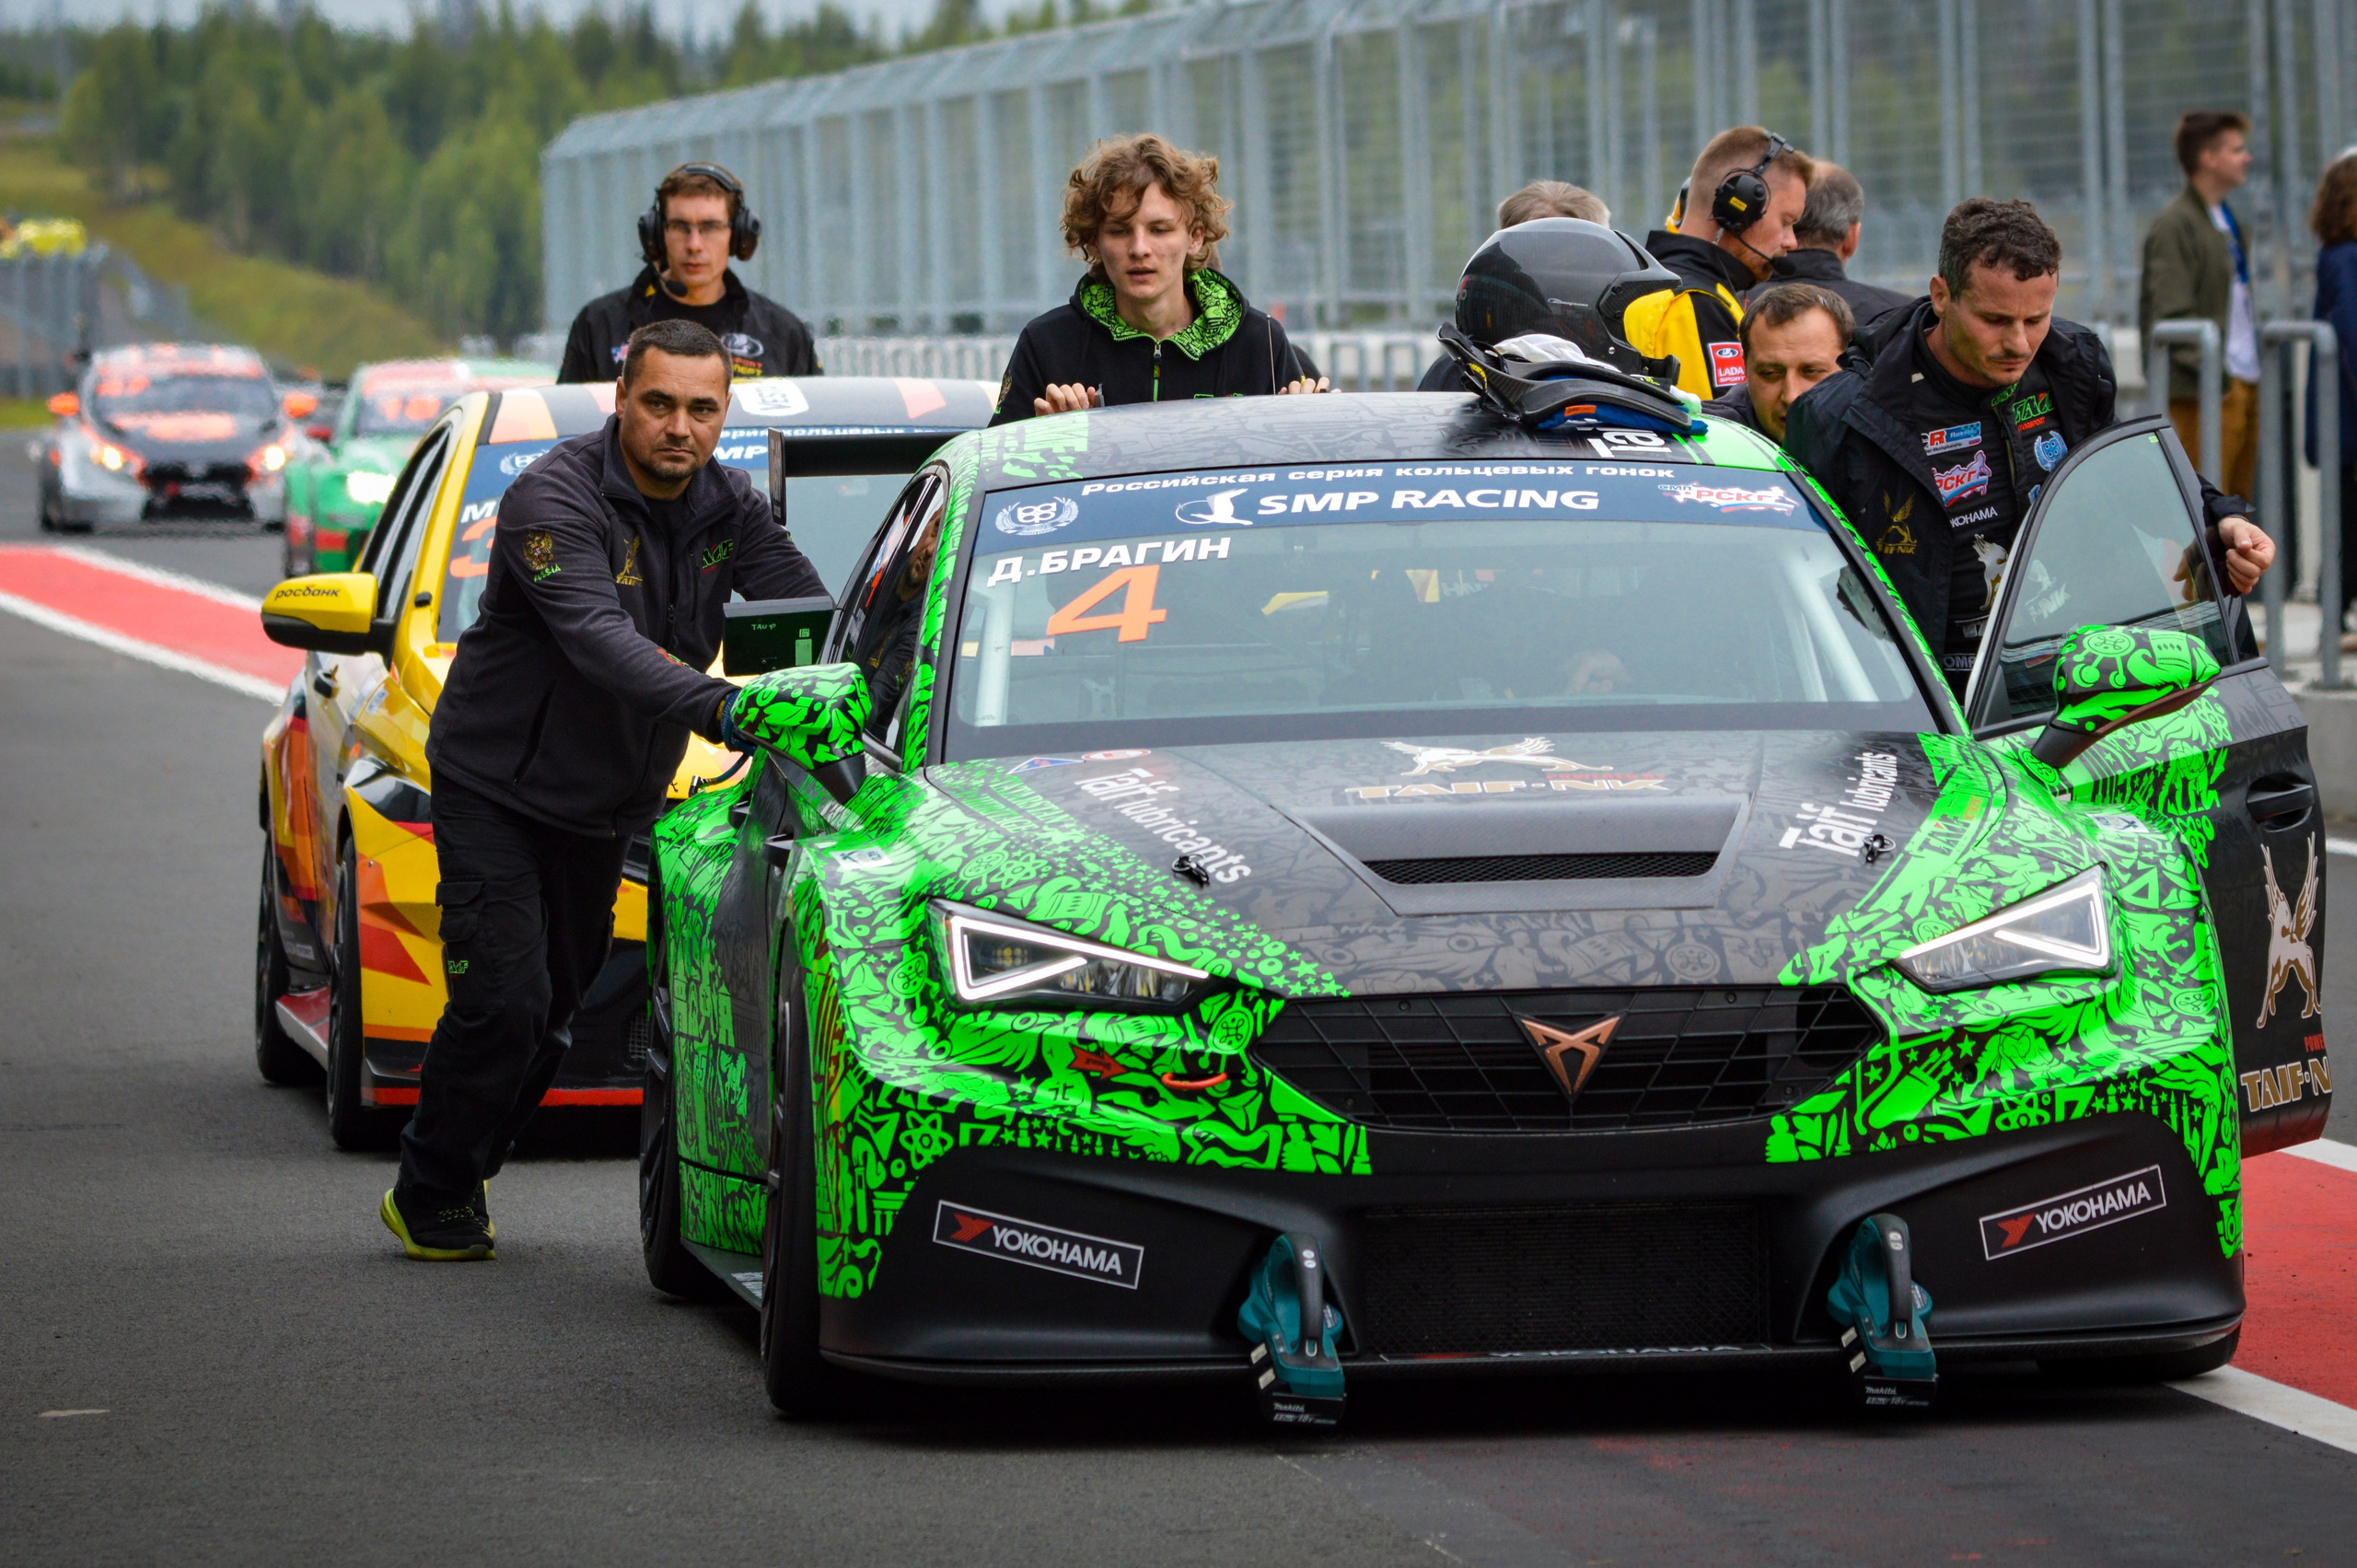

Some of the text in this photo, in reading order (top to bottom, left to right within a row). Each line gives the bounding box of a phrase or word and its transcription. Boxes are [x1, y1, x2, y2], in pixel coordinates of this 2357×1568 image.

[1718, 366, 1745, 377] LADA
[714, 445, 768, 460] MP
[1081, 465, 1676, 497] Российская серия кольцевых гонок
[1257, 488, 1600, 516] SMP RACING
[1695, 489, 1772, 503] РСКГ
[1949, 505, 1998, 528] KOHAMA
[533, 563, 562, 582] RUSSIA
[987, 536, 1233, 588] Д.БРАГИН
[274, 585, 341, 601] росбанк
[1046, 563, 1167, 645] 4
[1839, 750, 1898, 811] lubricants
[1113, 798, 1252, 884] lubricants
[2304, 1033, 2326, 1052] POWE
[2035, 1180, 2153, 1235] YOKOHAMA
[992, 1225, 1123, 1277] YOKOHAMA
